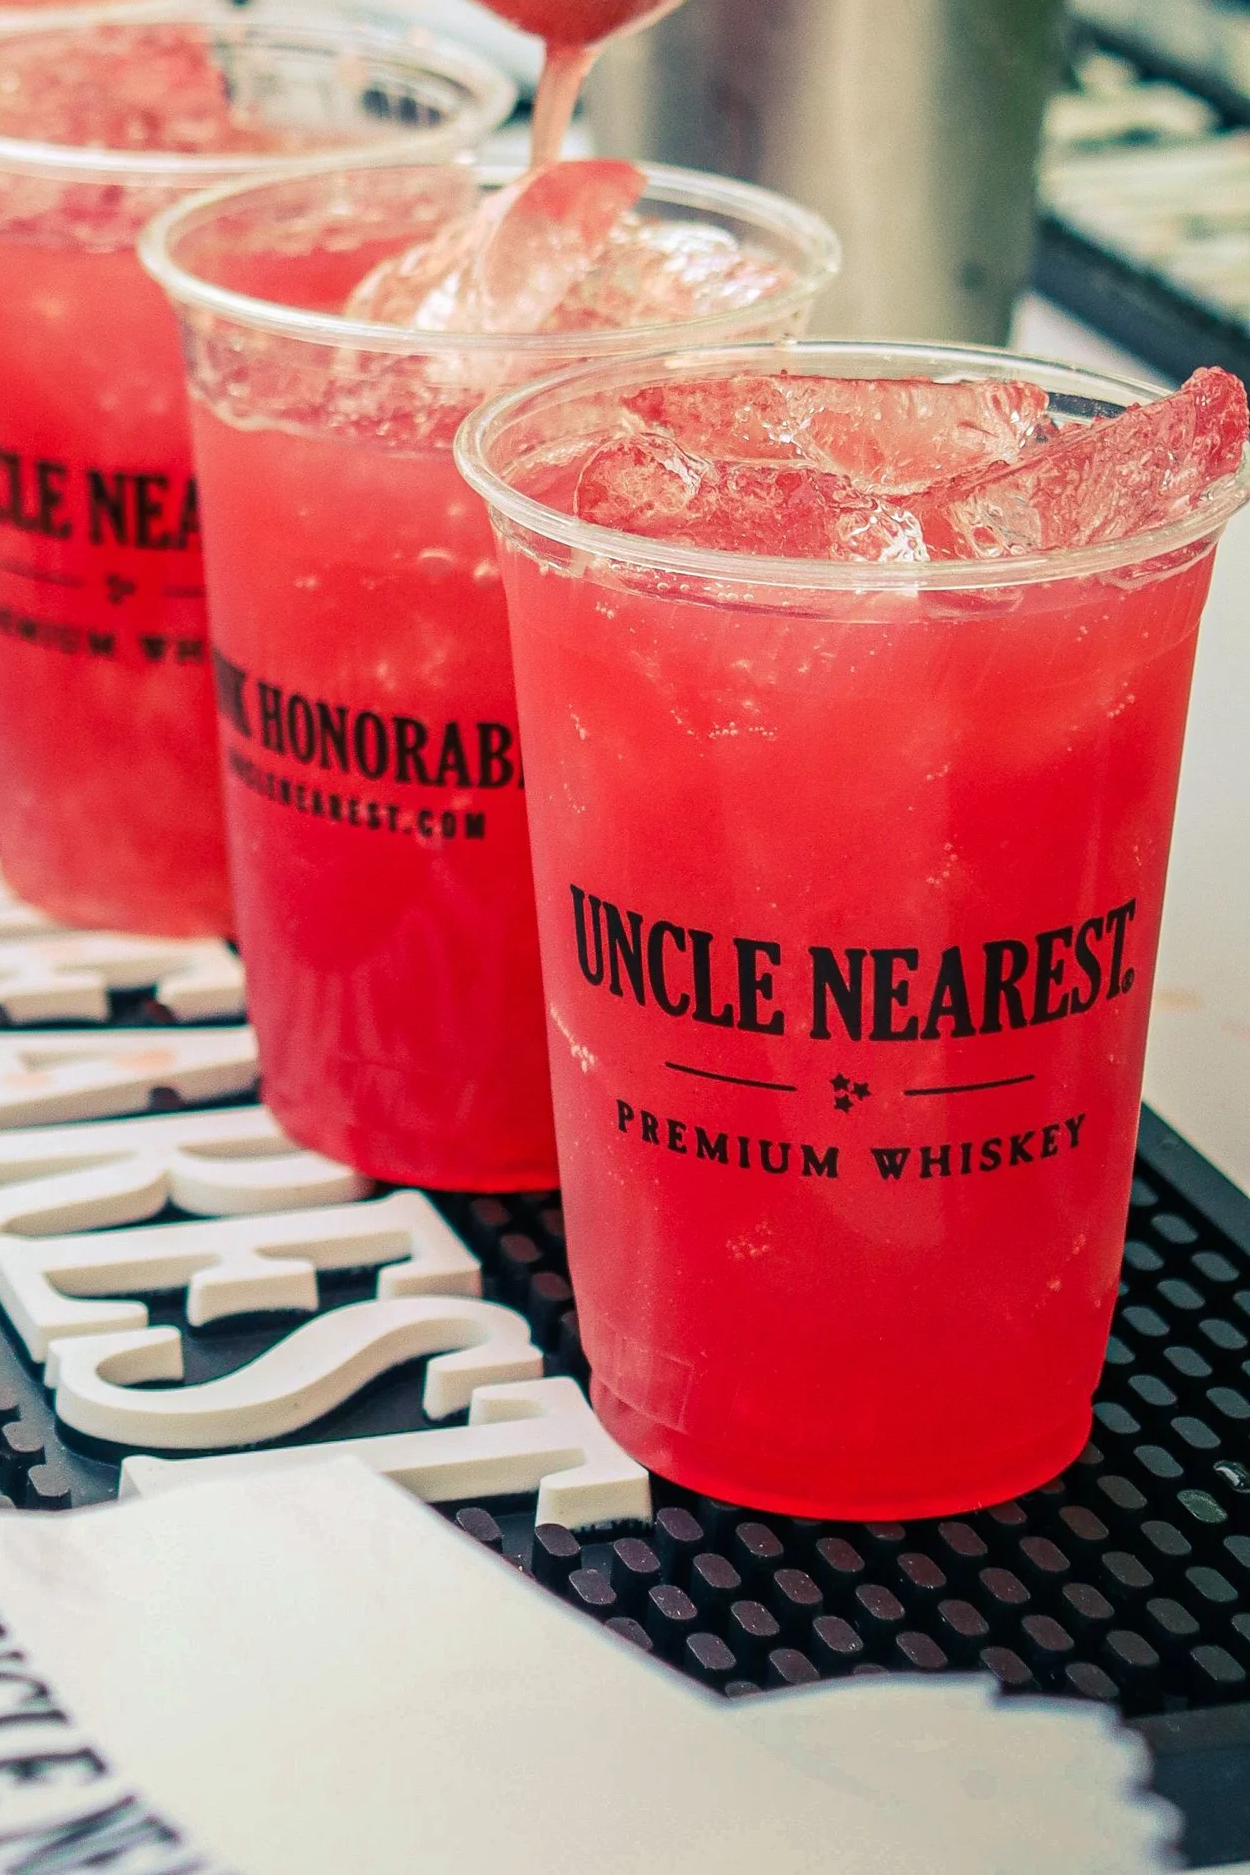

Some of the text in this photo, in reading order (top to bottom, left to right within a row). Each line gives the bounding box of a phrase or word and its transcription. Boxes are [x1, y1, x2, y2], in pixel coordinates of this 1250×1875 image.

[257, 678, 525, 791] HONORAB
[569, 883, 786, 1036] UNCLE
[615, 1098, 1087, 1181] PREMIUM WHISKEY
